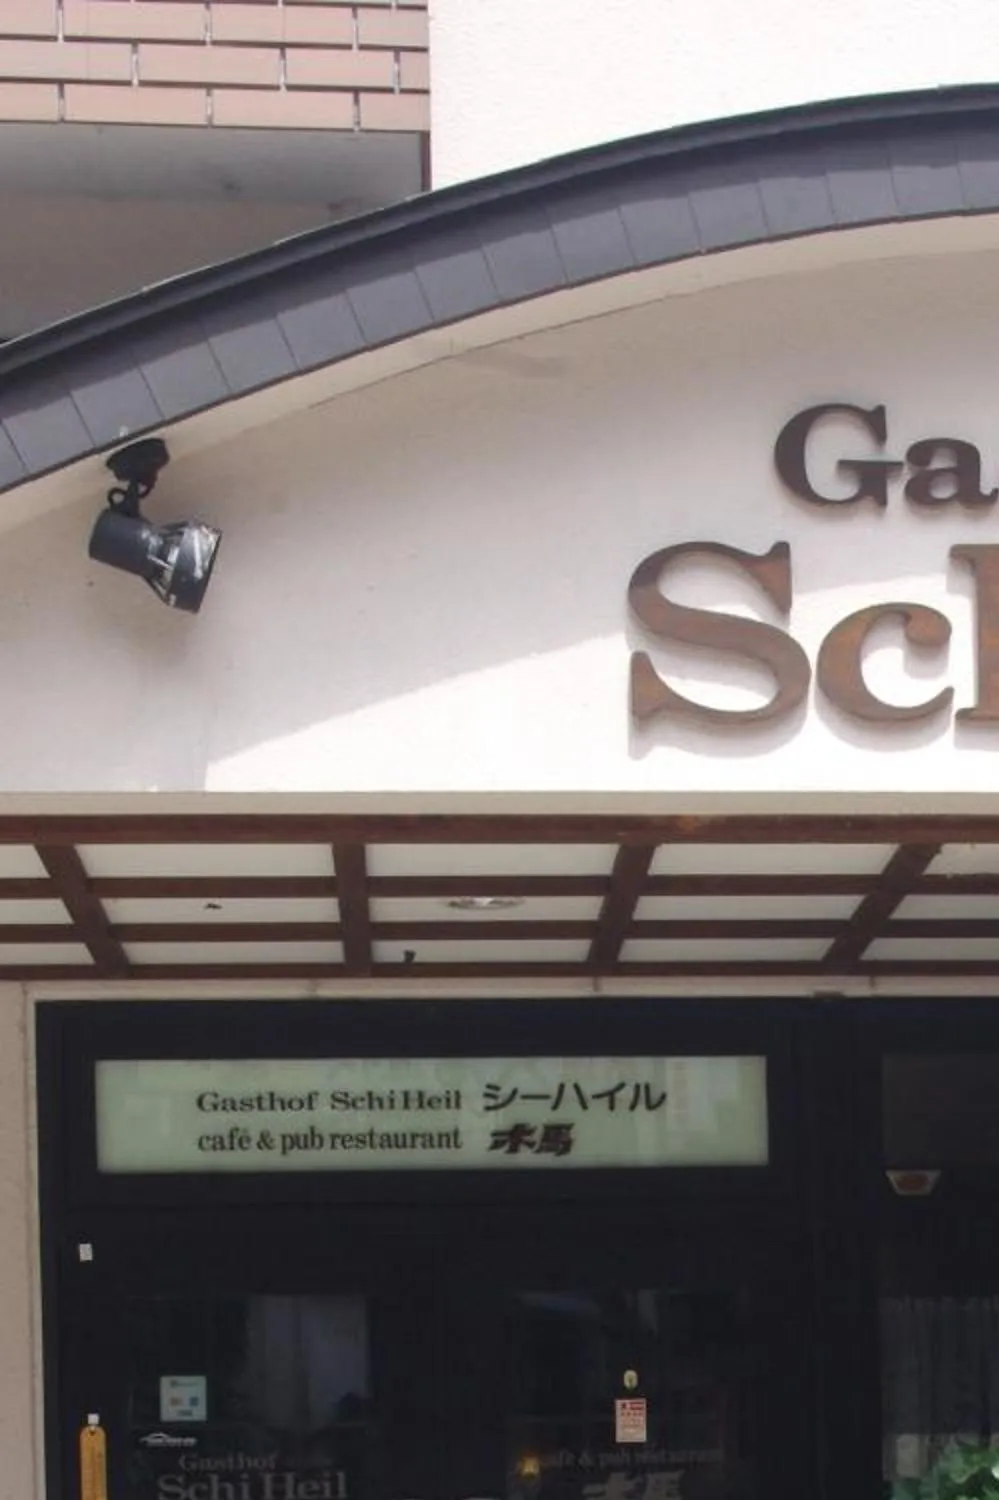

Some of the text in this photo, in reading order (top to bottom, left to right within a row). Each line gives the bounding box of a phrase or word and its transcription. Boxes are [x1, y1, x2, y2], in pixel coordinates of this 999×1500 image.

[196, 1089, 319, 1113] Gasthof
[482, 1081, 668, 1113] シーハイル
[255, 1129, 275, 1152] &
[280, 1125, 325, 1157] pub
[329, 1125, 464, 1151] restaurant
